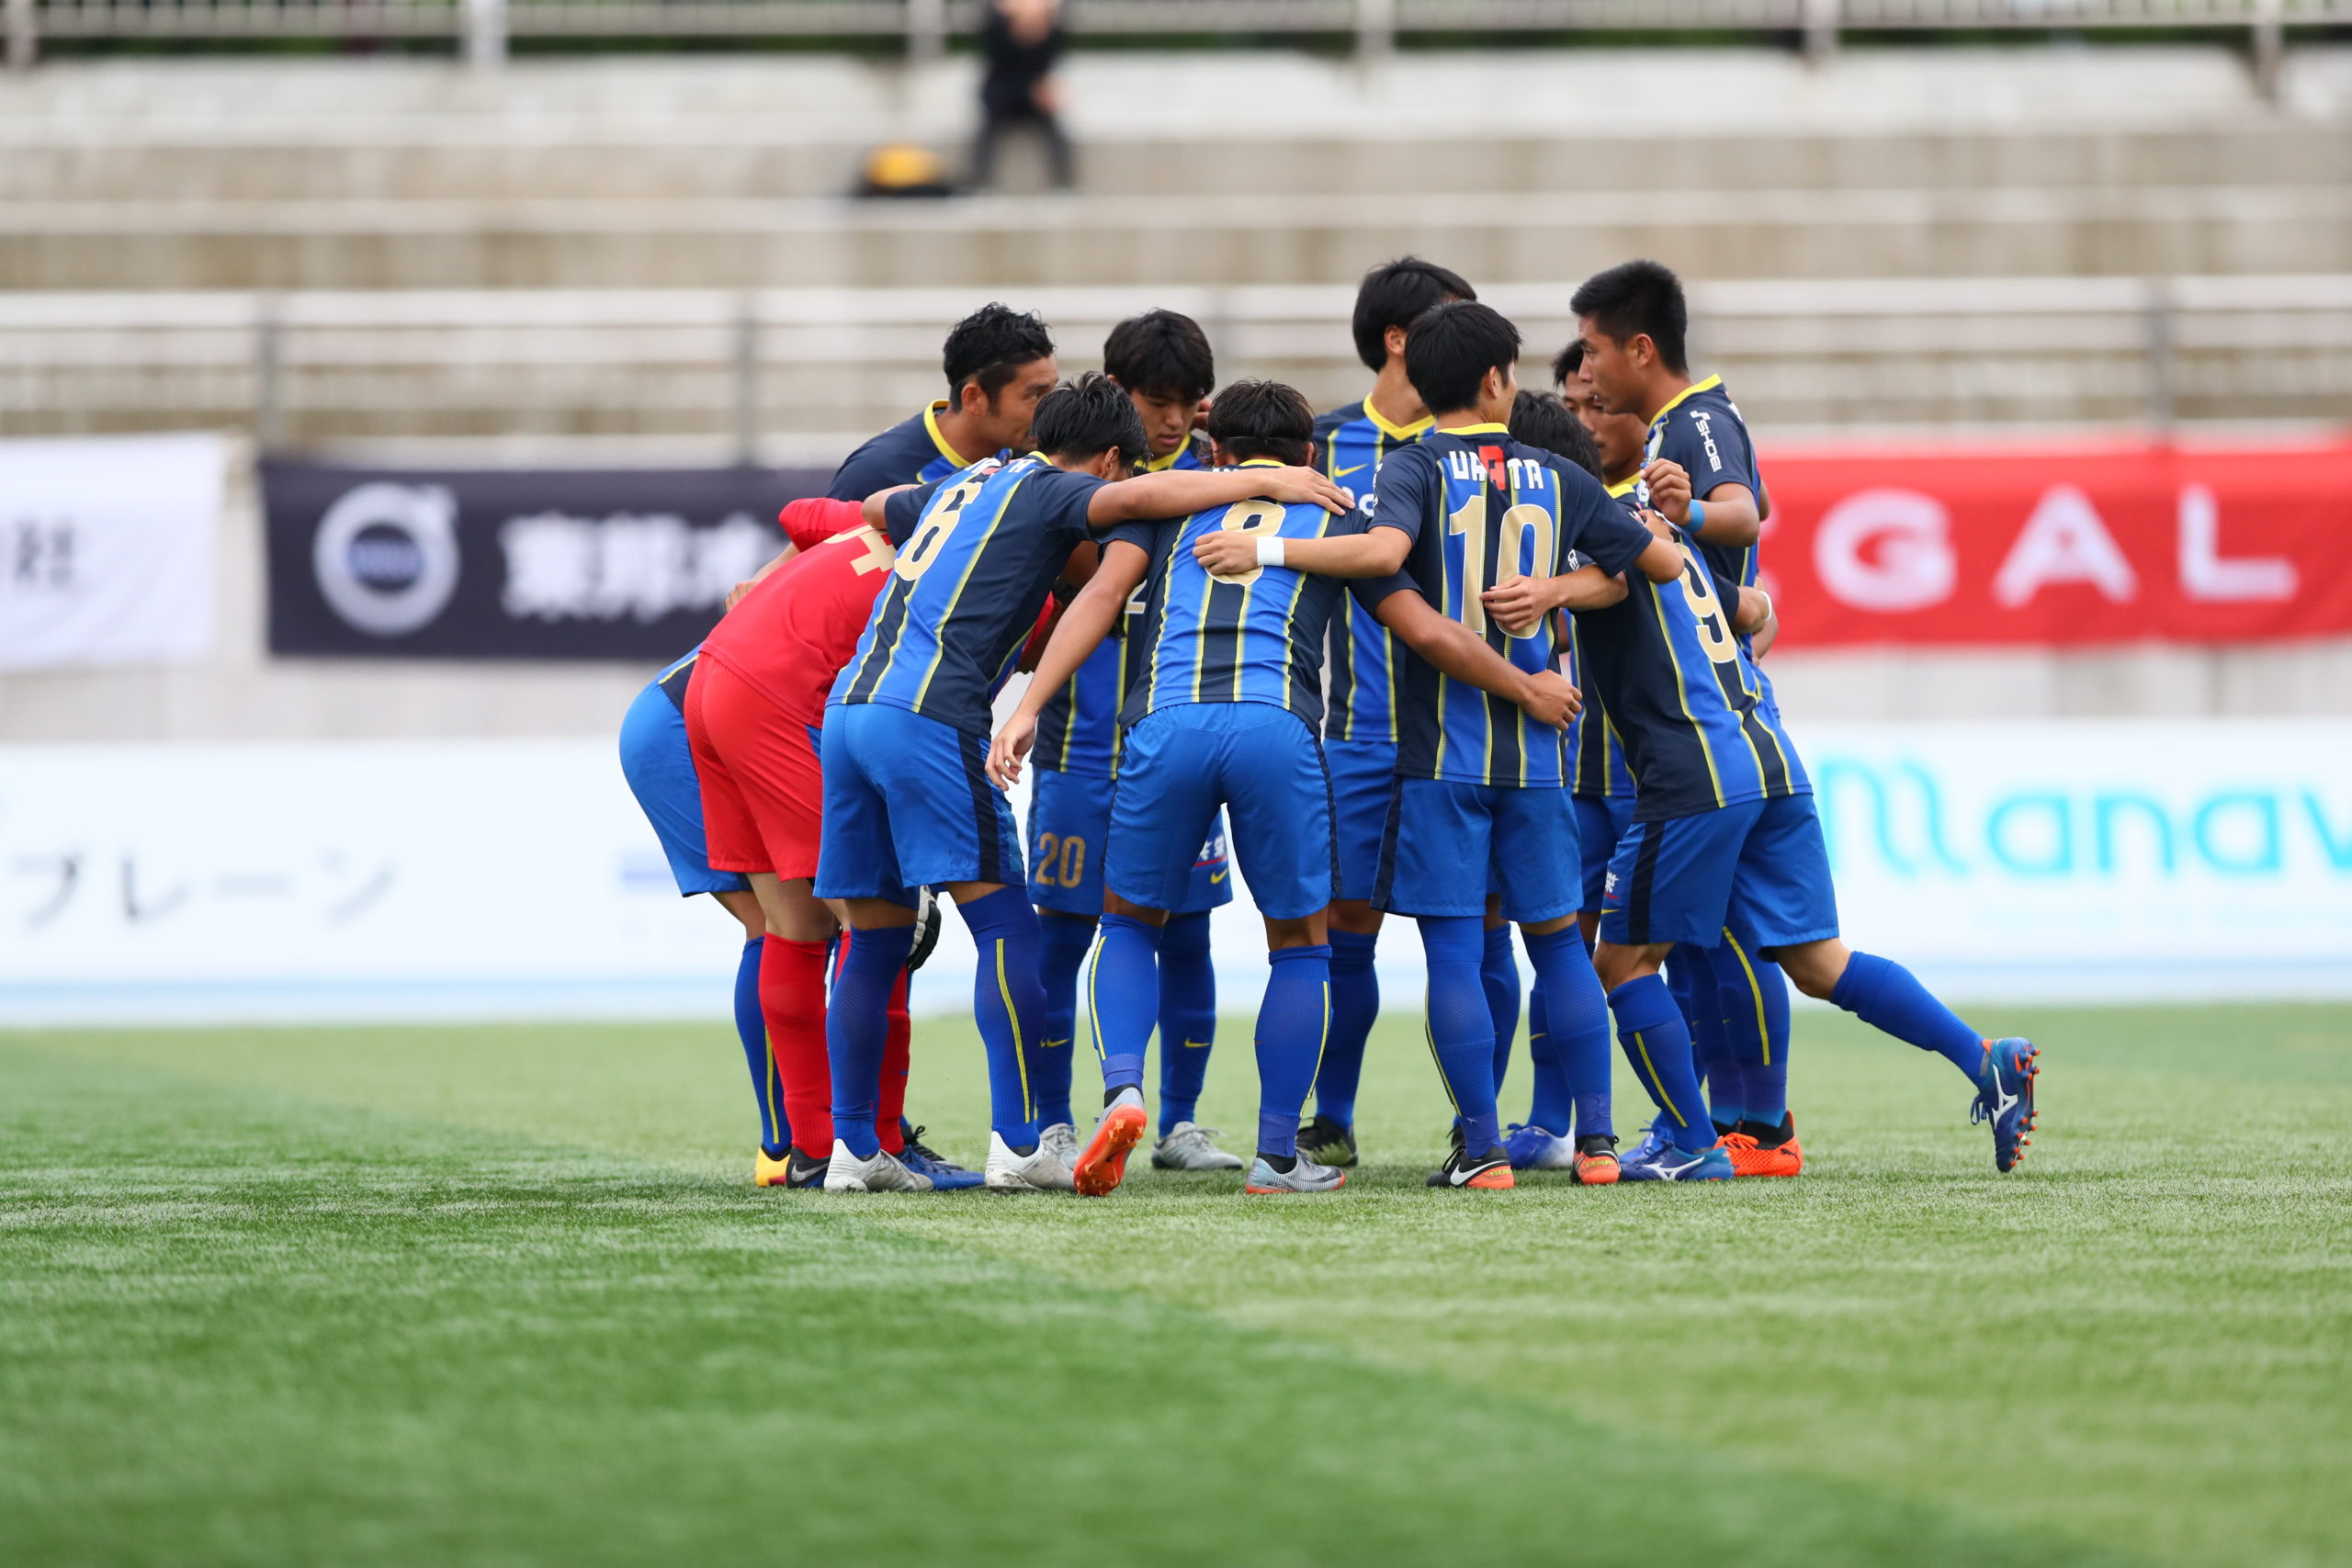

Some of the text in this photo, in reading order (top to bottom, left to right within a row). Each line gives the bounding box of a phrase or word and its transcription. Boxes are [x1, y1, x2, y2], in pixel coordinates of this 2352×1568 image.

[1694, 418, 1723, 474] SHOEI
[893, 481, 983, 581] 6
[1220, 499, 1286, 587] 8
[1448, 494, 1554, 639] 10
[1758, 482, 2301, 614] GAL
[1669, 542, 1738, 664] 9
[1035, 831, 1087, 889] 20
